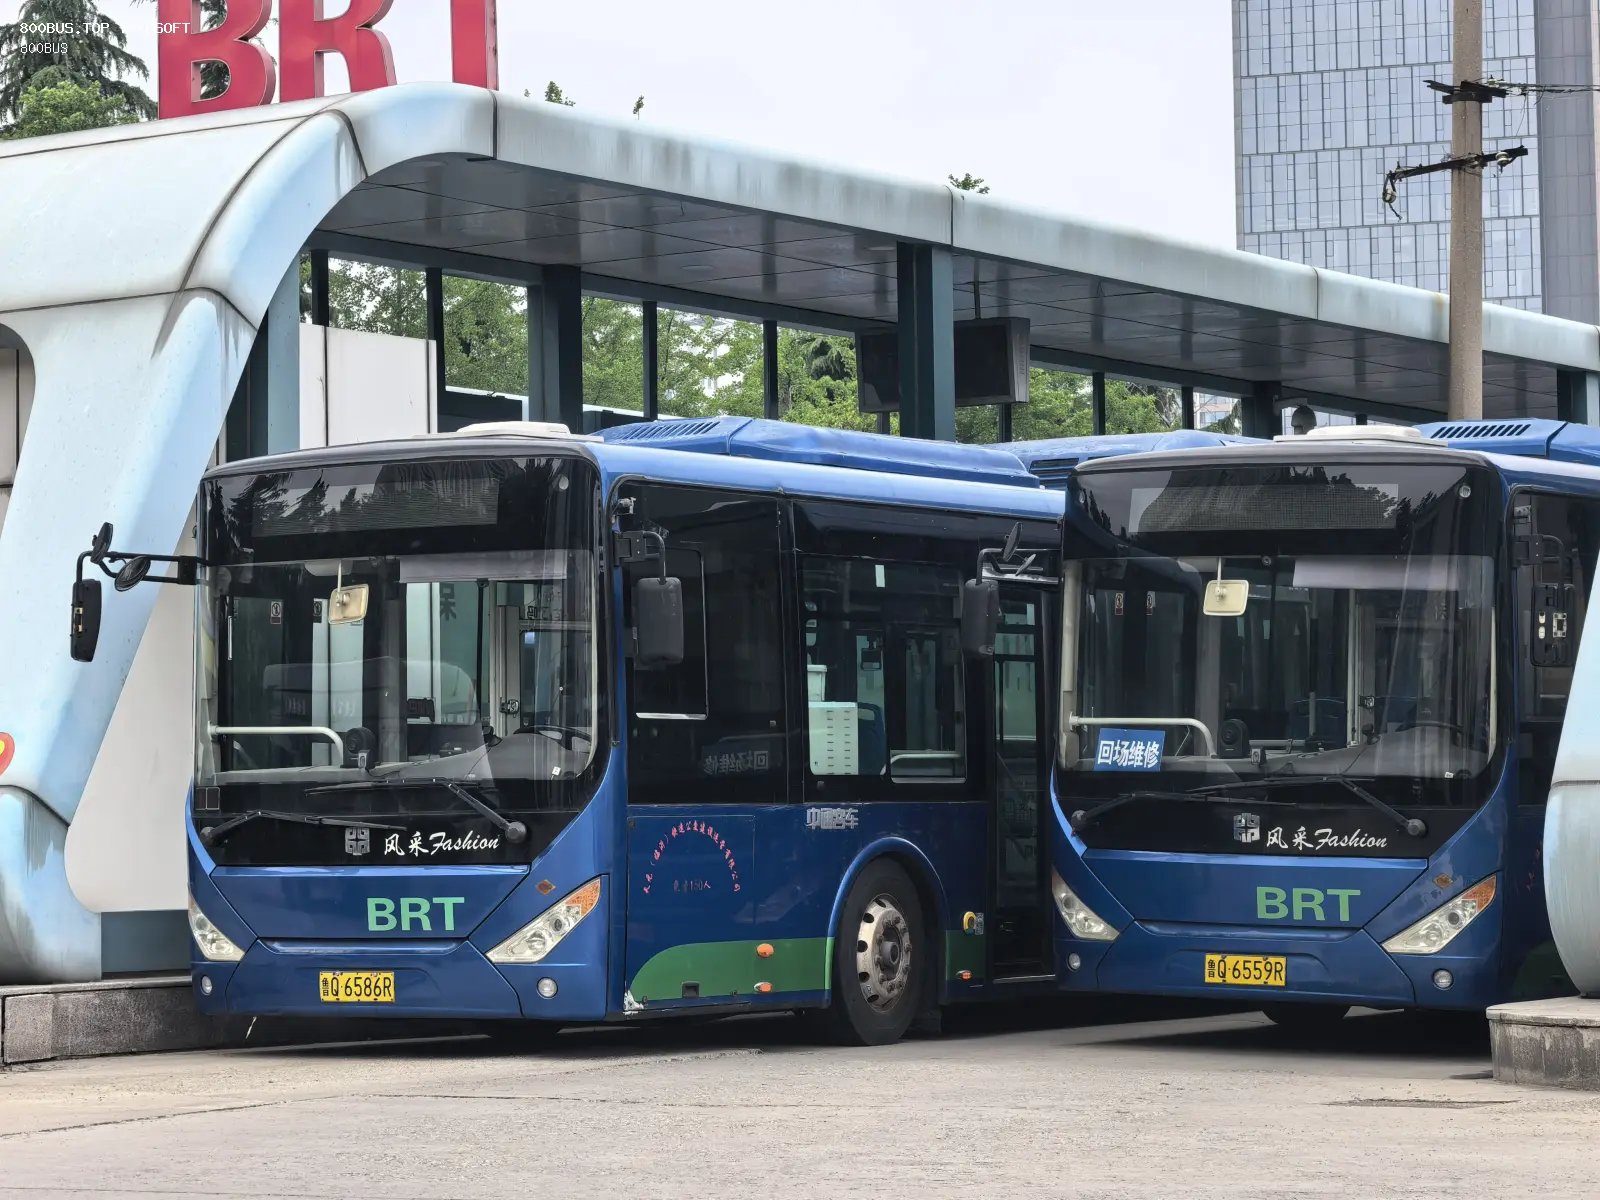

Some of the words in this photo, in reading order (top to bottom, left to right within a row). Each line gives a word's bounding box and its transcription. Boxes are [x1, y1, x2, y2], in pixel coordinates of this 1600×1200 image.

[1098, 740, 1160, 768] 回场维修
[429, 830, 499, 856] Fashion
[1314, 828, 1387, 850] Fashion
[367, 897, 465, 931] BRT
[1256, 886, 1361, 921] BRT
